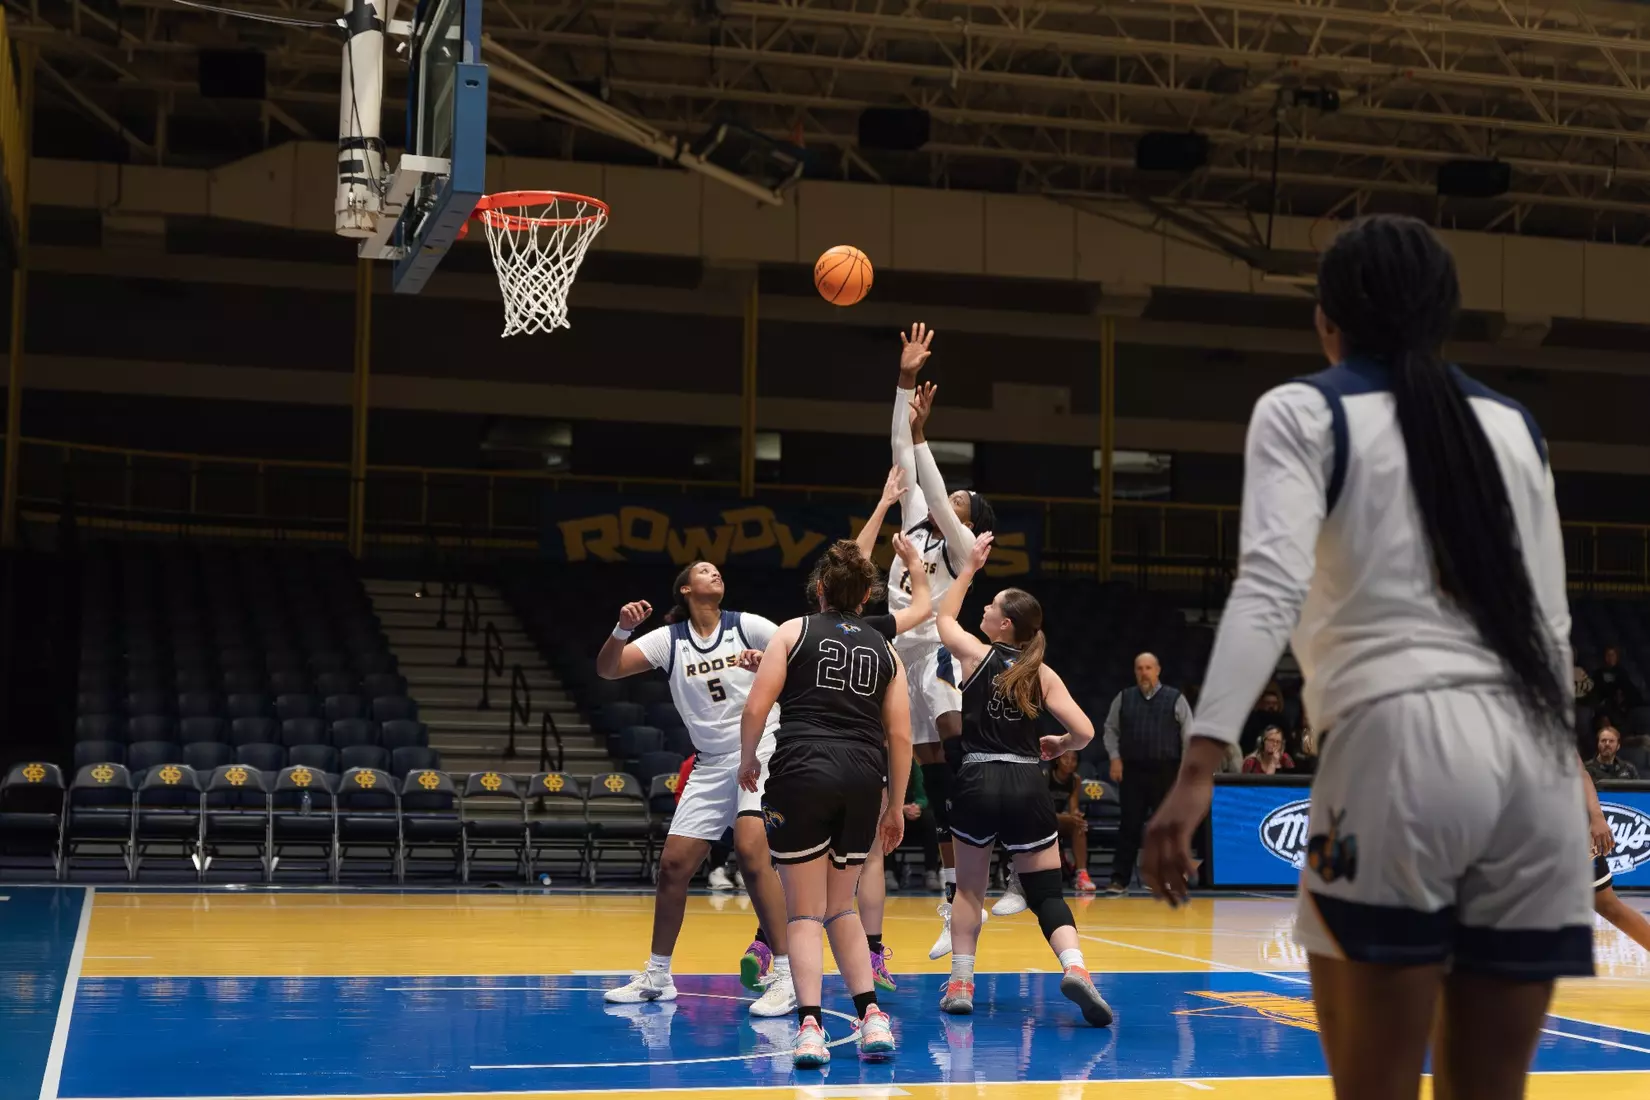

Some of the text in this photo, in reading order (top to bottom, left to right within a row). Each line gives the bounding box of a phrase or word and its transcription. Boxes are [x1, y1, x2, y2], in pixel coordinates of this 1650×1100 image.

[556, 505, 827, 569] ROWDY
[686, 654, 737, 677] ROOS
[816, 638, 879, 697] 20
[706, 677, 727, 703] 5
